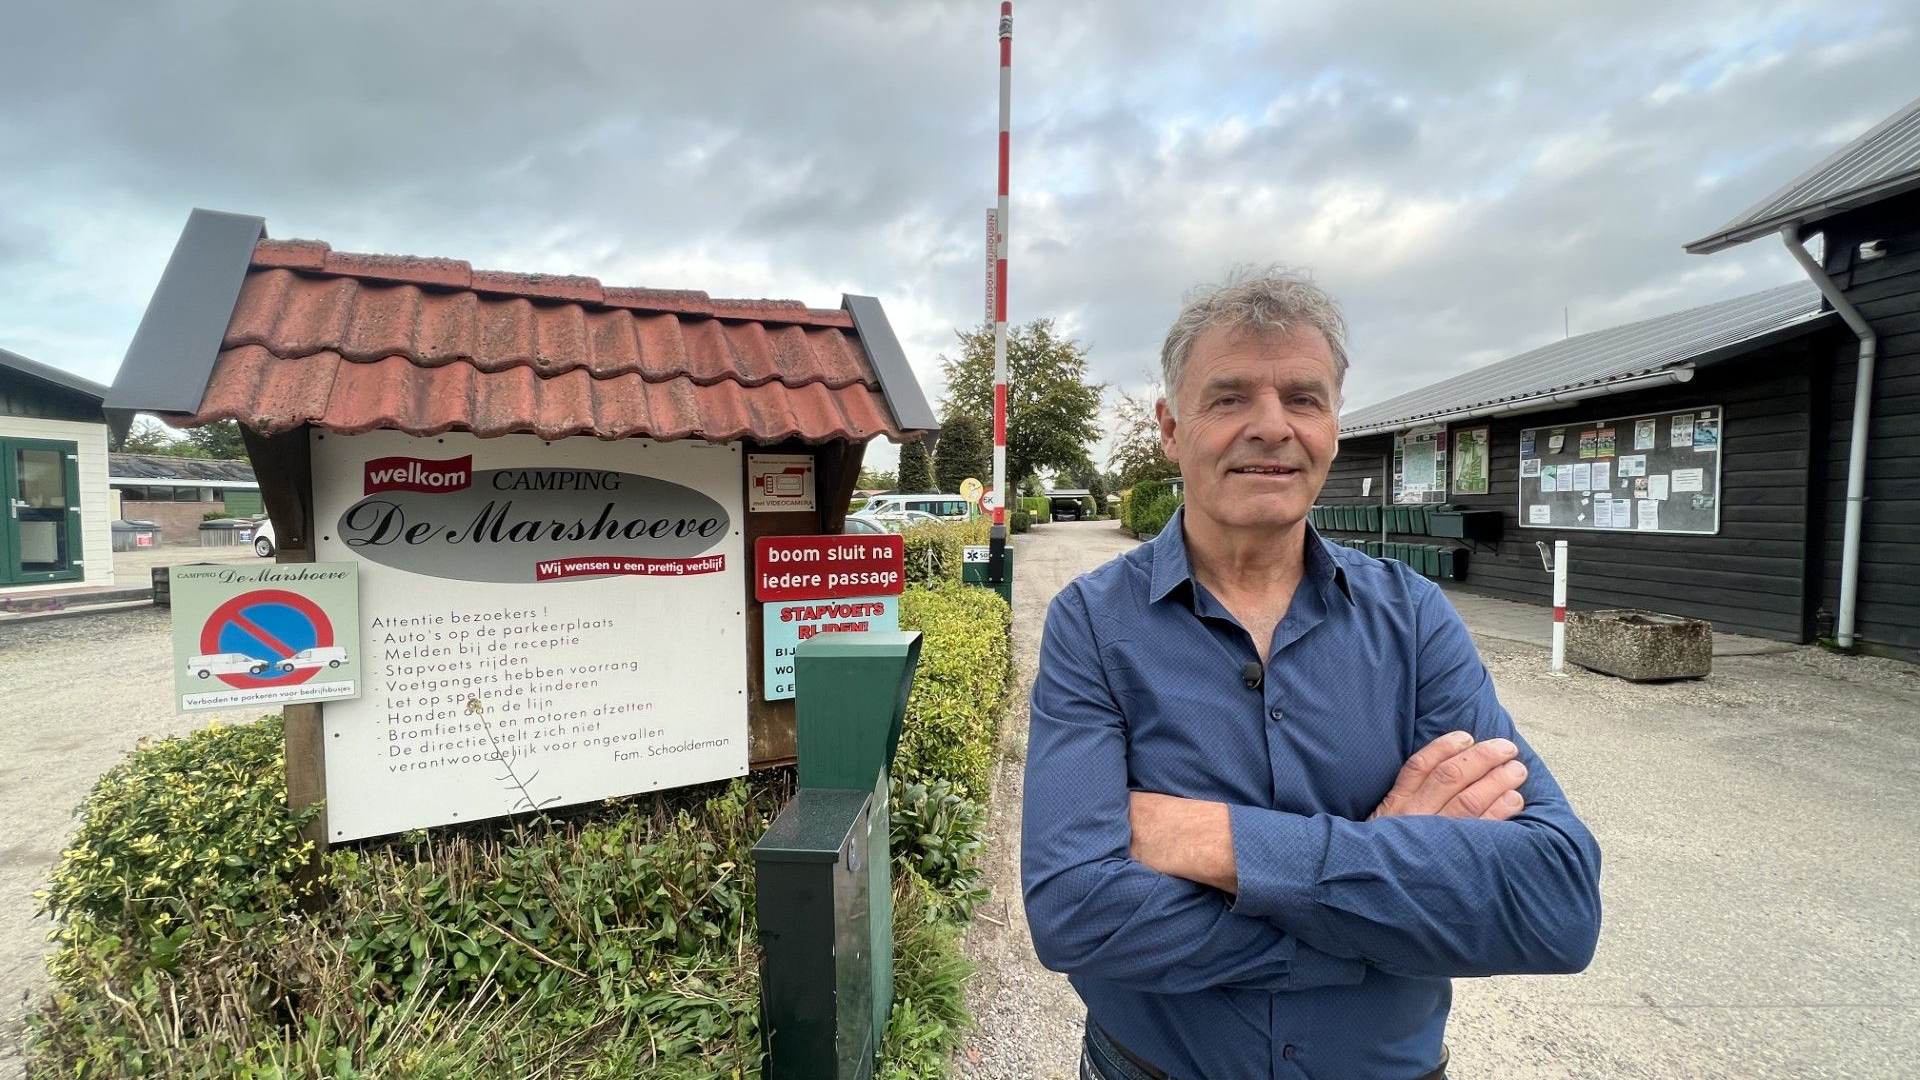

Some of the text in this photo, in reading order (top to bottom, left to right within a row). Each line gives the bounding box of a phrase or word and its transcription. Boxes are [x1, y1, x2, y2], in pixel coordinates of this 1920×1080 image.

[986, 271, 994, 320] SLAGBOOM
[370, 461, 466, 487] welkom
[492, 470, 622, 491] CAMPING
[346, 500, 726, 546] De Marshoeve
[768, 544, 893, 563] boom sluit na
[177, 568, 349, 583] CAMPING De Marshoeve
[539, 560, 562, 576] Wij
[565, 561, 610, 571] wensen
[623, 562, 645, 571] een
[648, 561, 684, 574] prettig
[686, 557, 723, 571] verblijf
[762, 570, 898, 590] iedere passage
[372, 613, 444, 628] Attentie
[450, 607, 537, 624] bezoekers
[780, 602, 884, 622] STAPVOETS
[384, 618, 614, 644] Auto's op de parkeerplaats
[385, 636, 580, 661] Melden bij de receptie
[386, 655, 528, 677] Stapvoets rijden
[386, 661, 639, 692] Voetgangers hebben voorrang
[186, 696, 229, 707] Verboden
[241, 692, 278, 703] parkeren
[279, 690, 297, 698] voor
[387, 679, 598, 709] Let op spelende kinderen
[388, 697, 553, 724] Honden aan de lijn
[389, 702, 653, 741] Bromfietsen en motoren afzetten
[389, 722, 601, 757] De directie stelt zich niet
[389, 727, 665, 773] verantwoordelijk voor ongevallen
[614, 738, 730, 761] Fam. Schoolderman
